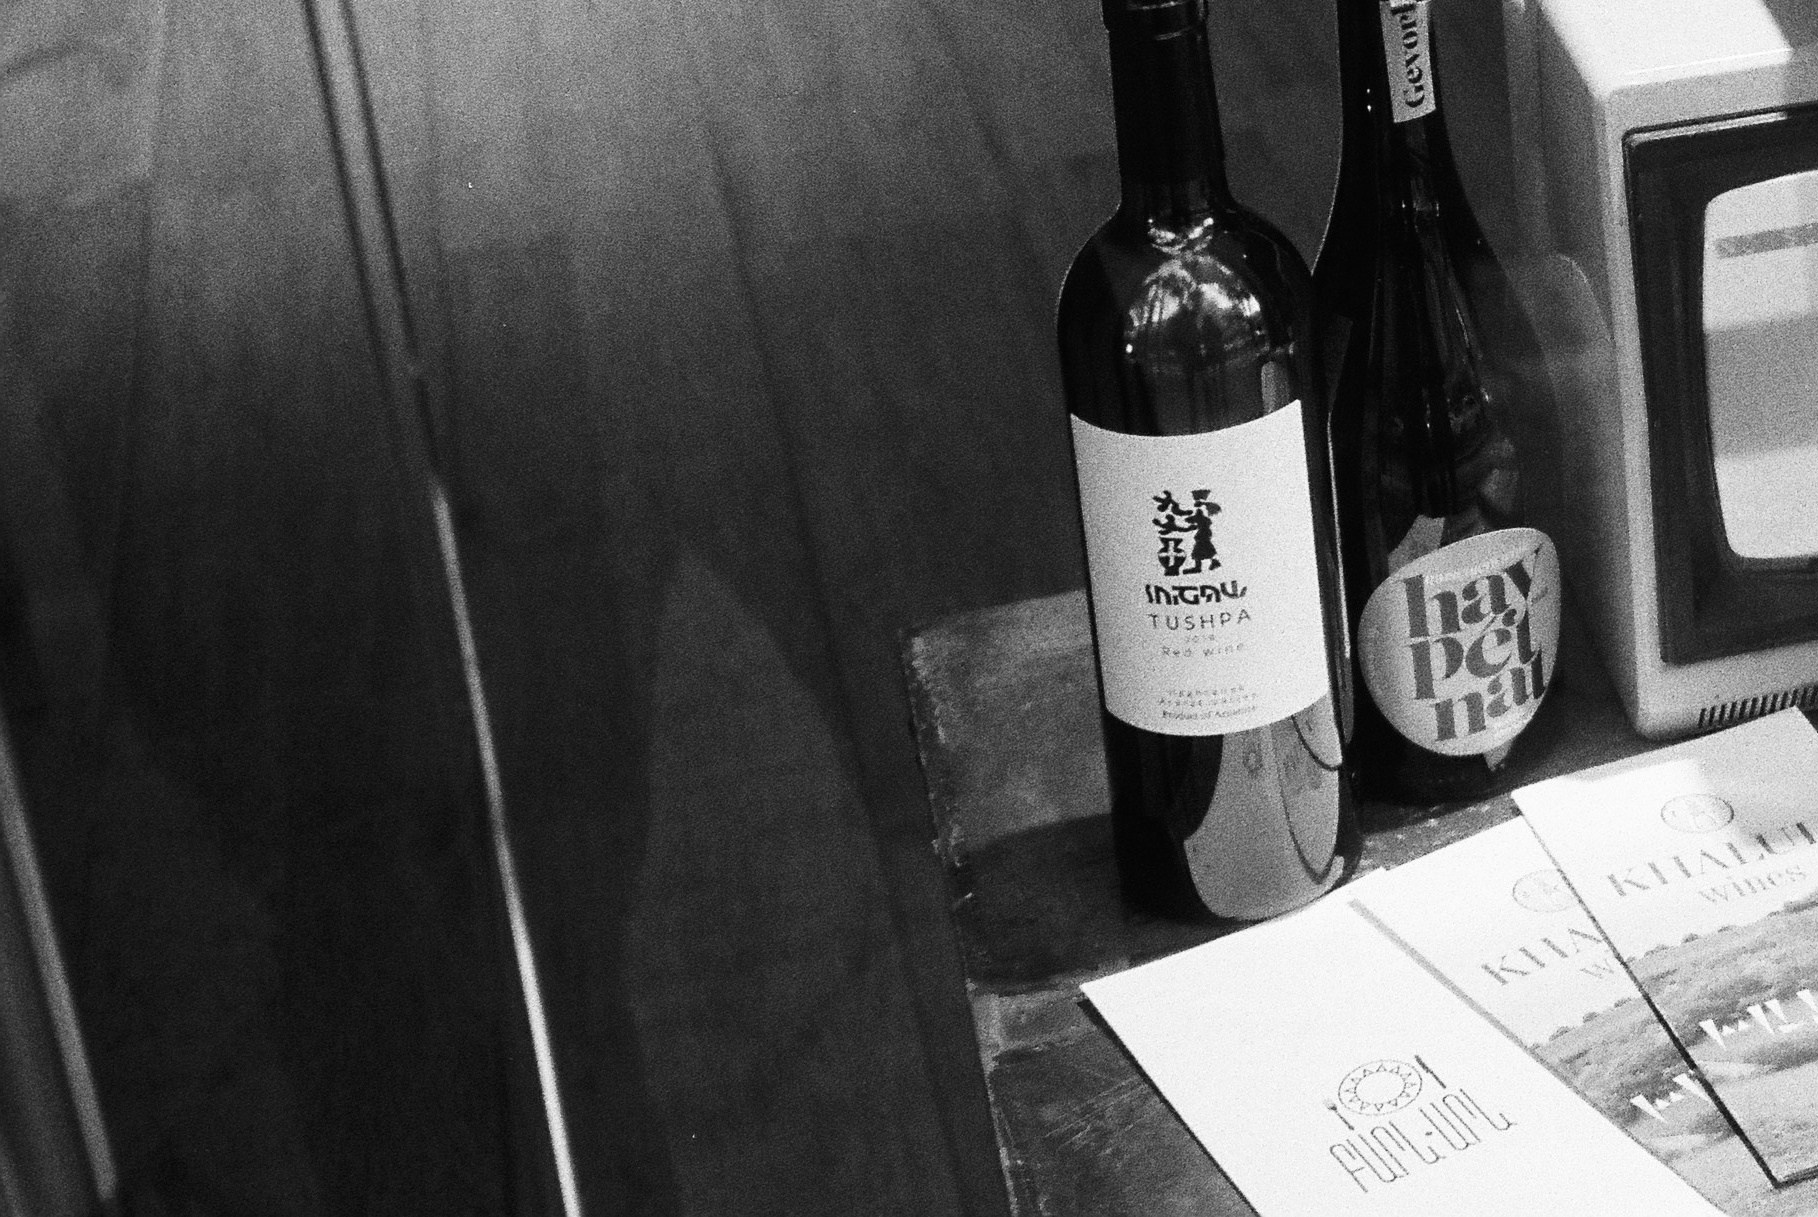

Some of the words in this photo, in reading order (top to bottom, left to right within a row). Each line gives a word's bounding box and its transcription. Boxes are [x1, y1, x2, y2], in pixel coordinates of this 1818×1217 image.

[1402, 542, 1546, 639] hay
[1147, 608, 1252, 631] TUSHPA
[1697, 863, 1809, 904] wines
